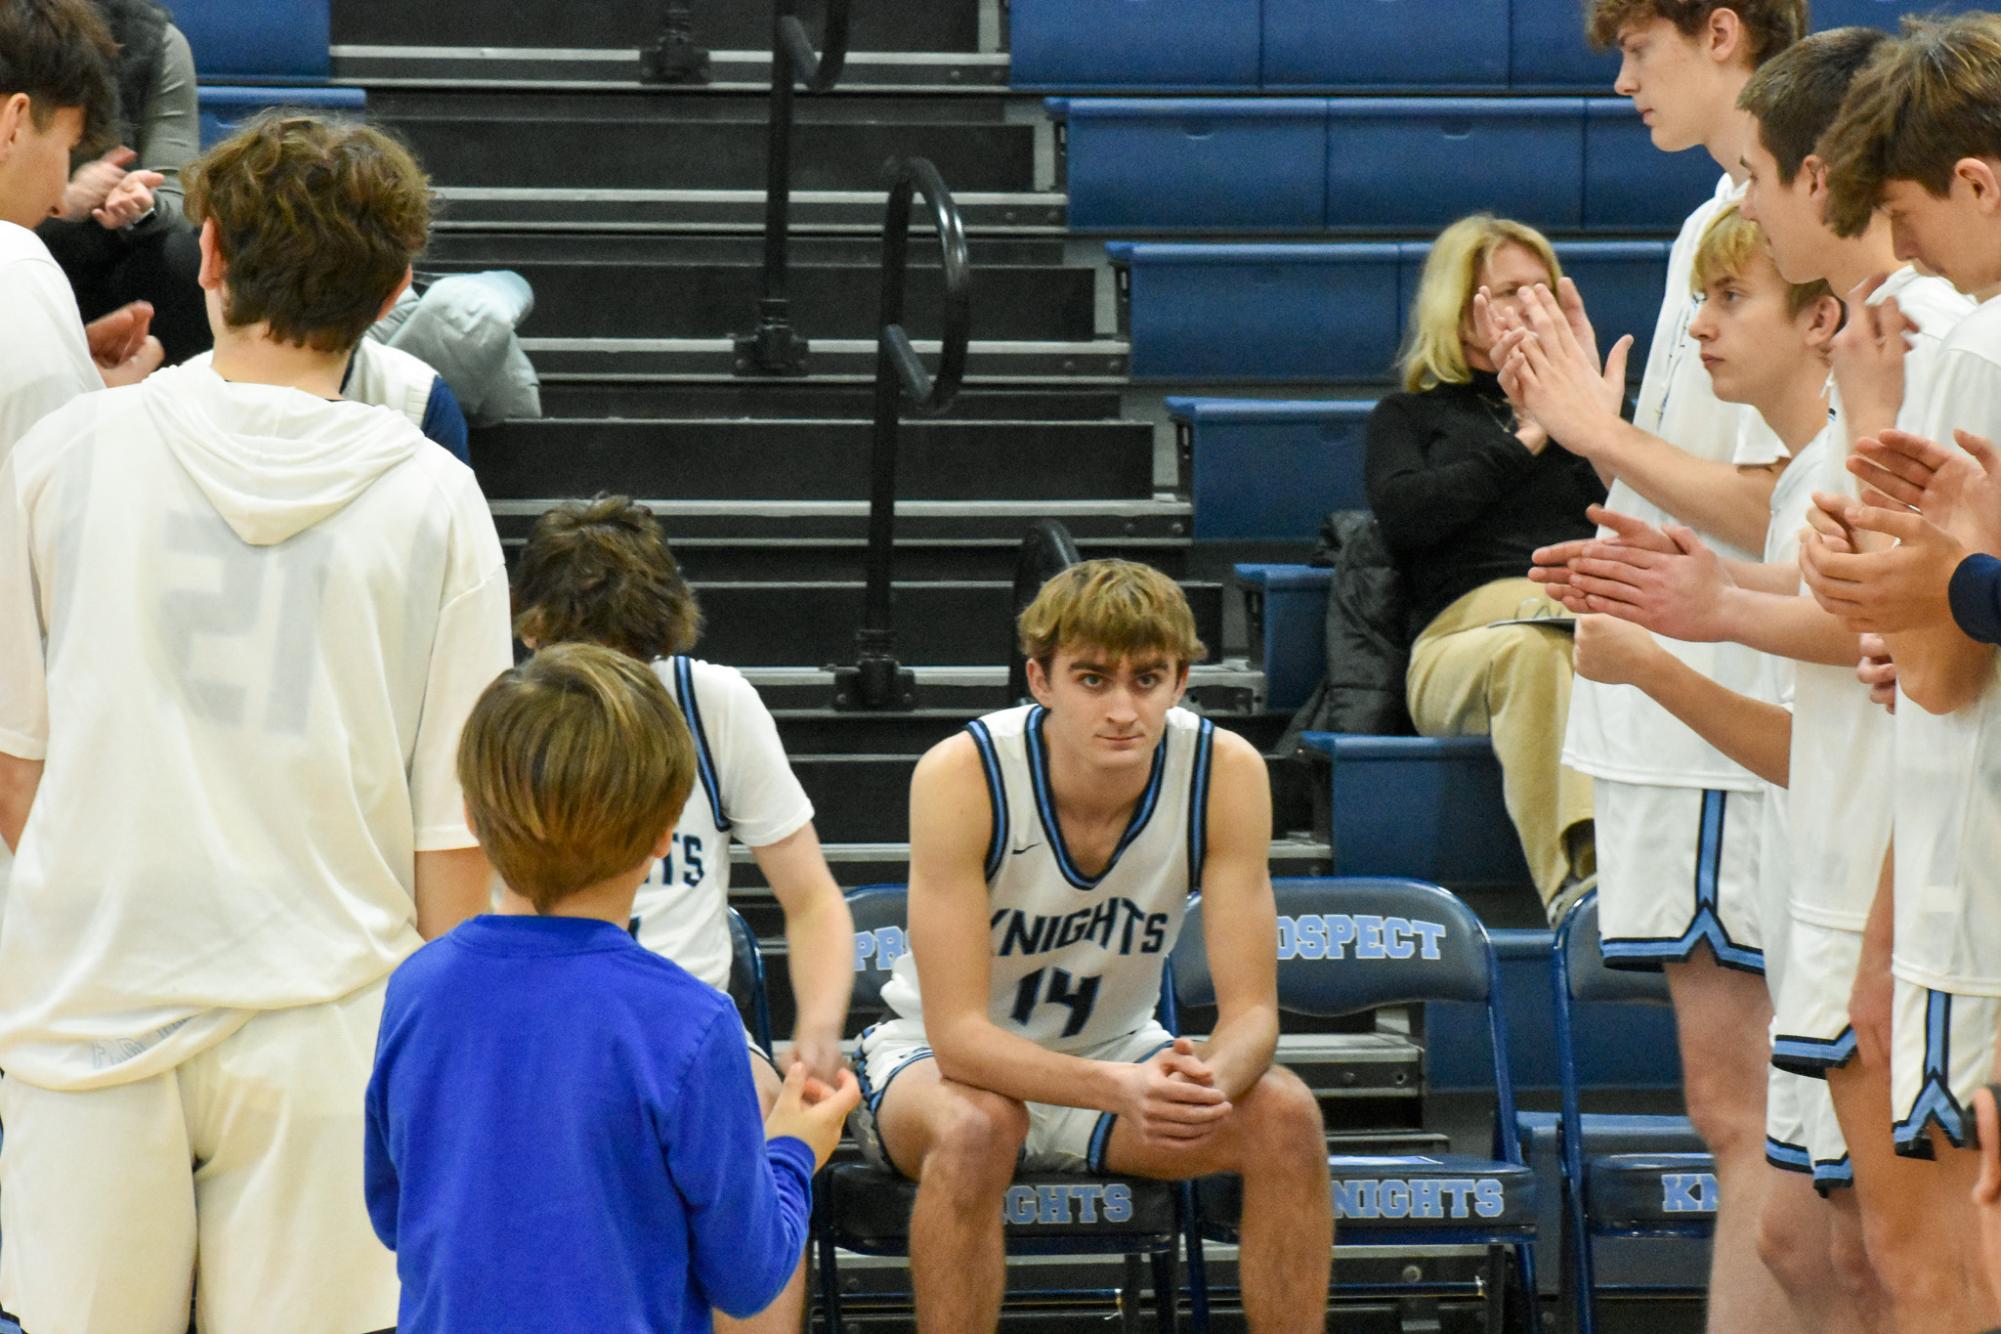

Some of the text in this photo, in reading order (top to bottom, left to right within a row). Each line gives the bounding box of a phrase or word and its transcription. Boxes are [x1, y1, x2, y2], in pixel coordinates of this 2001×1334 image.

[853, 925, 908, 972] PR
[1277, 914, 1447, 960] OSPECT
[1010, 966, 1103, 1038] 14
[1003, 1183, 1133, 1225] GHTS
